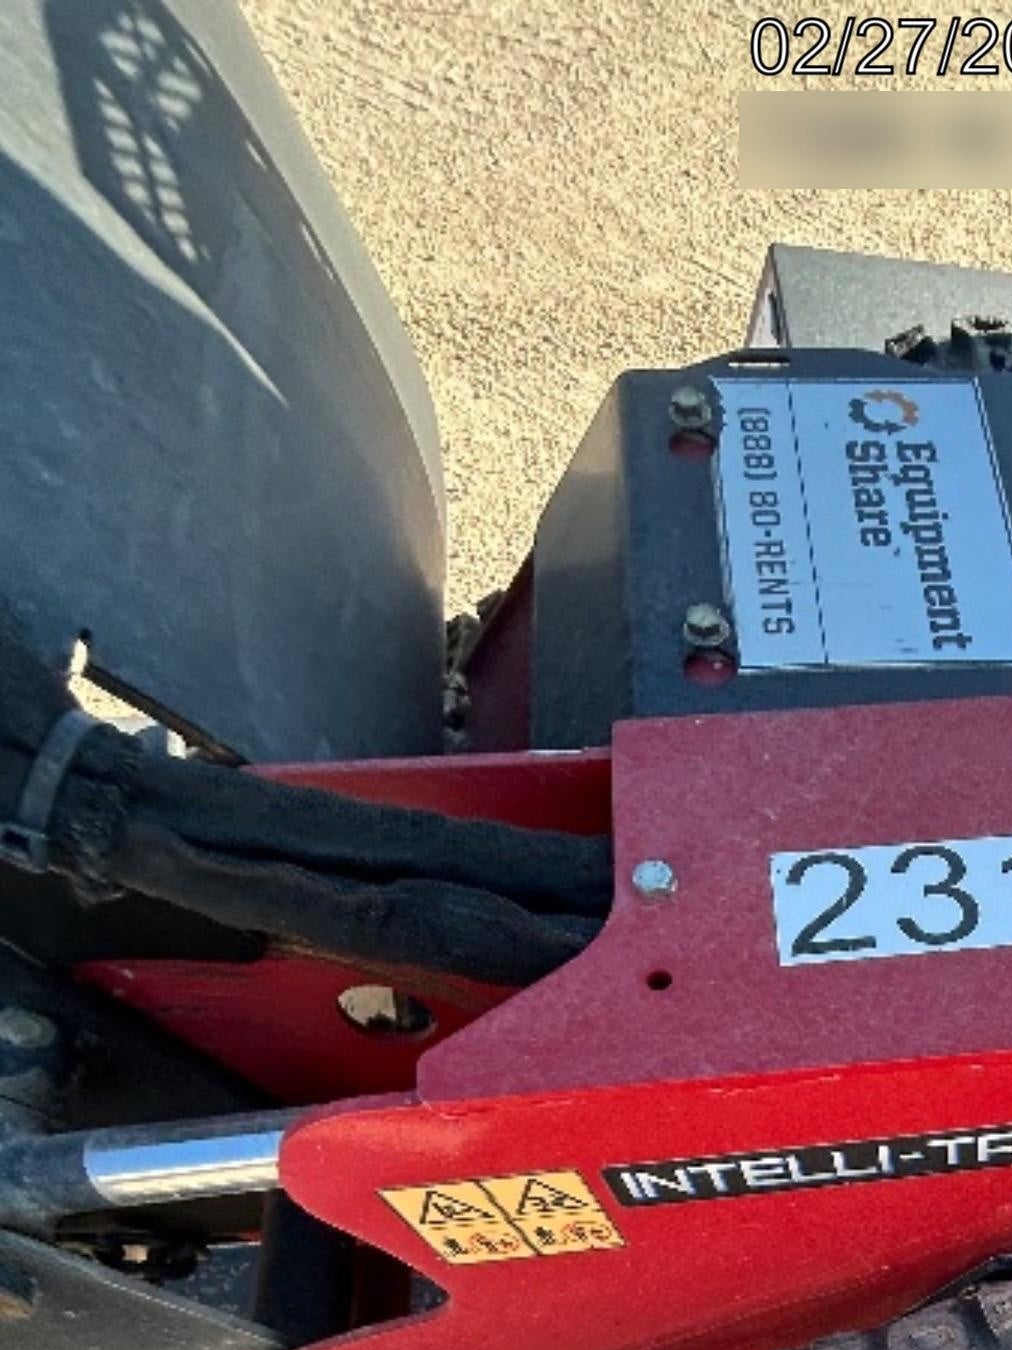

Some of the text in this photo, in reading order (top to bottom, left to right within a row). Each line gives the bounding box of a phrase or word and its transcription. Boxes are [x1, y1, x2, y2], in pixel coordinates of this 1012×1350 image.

[737, 407, 795, 635] (888) 80-RENTS
[846, 440, 892, 547] Share
[896, 441, 972, 650] Equipment
